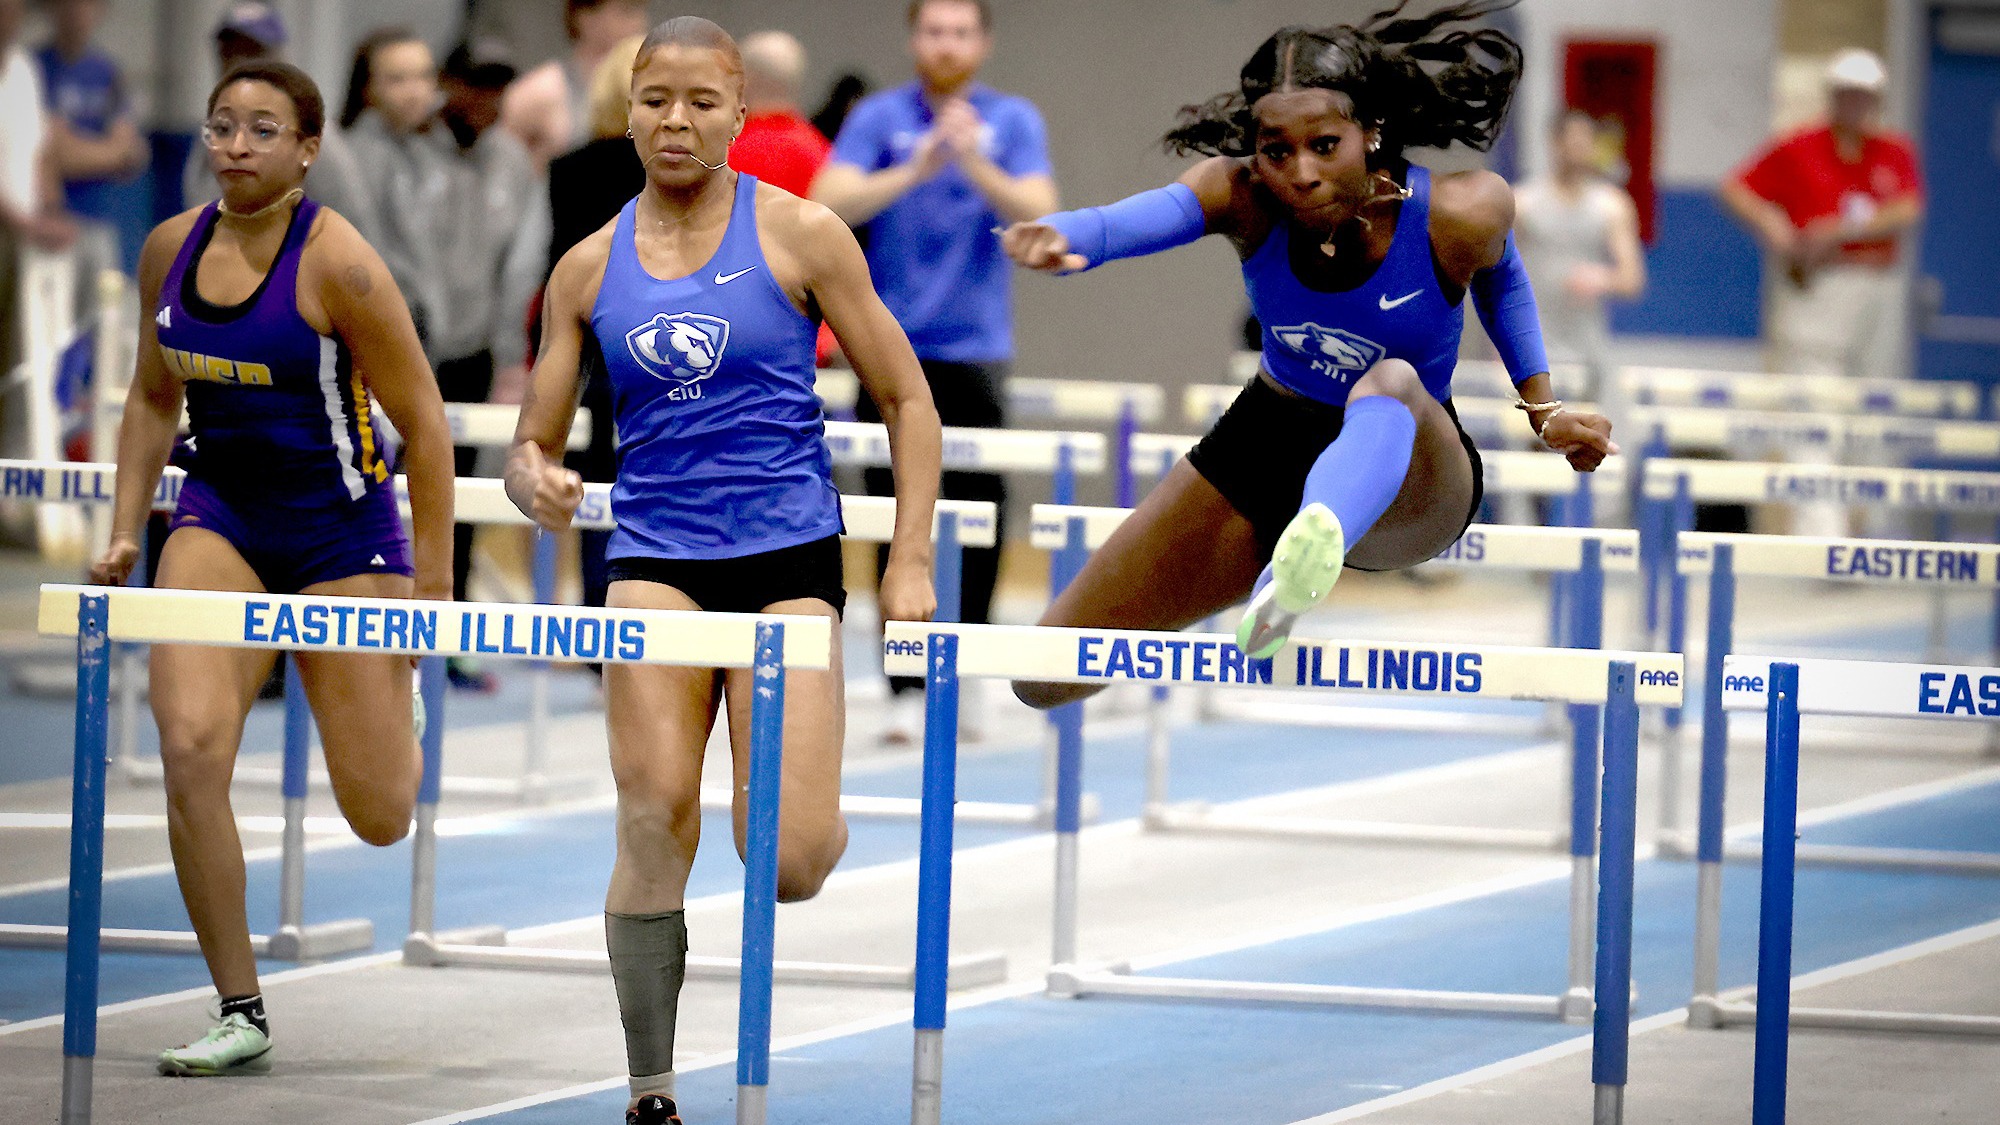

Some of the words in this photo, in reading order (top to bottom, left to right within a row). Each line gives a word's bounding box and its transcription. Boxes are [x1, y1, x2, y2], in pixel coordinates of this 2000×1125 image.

[1827, 545, 1979, 581] EASTERN
[244, 600, 437, 650] EASTERN
[460, 612, 646, 660] ILLINOIS
[1077, 636, 1273, 684] EASTERN
[1296, 645, 1482, 692] ILLINOIS
